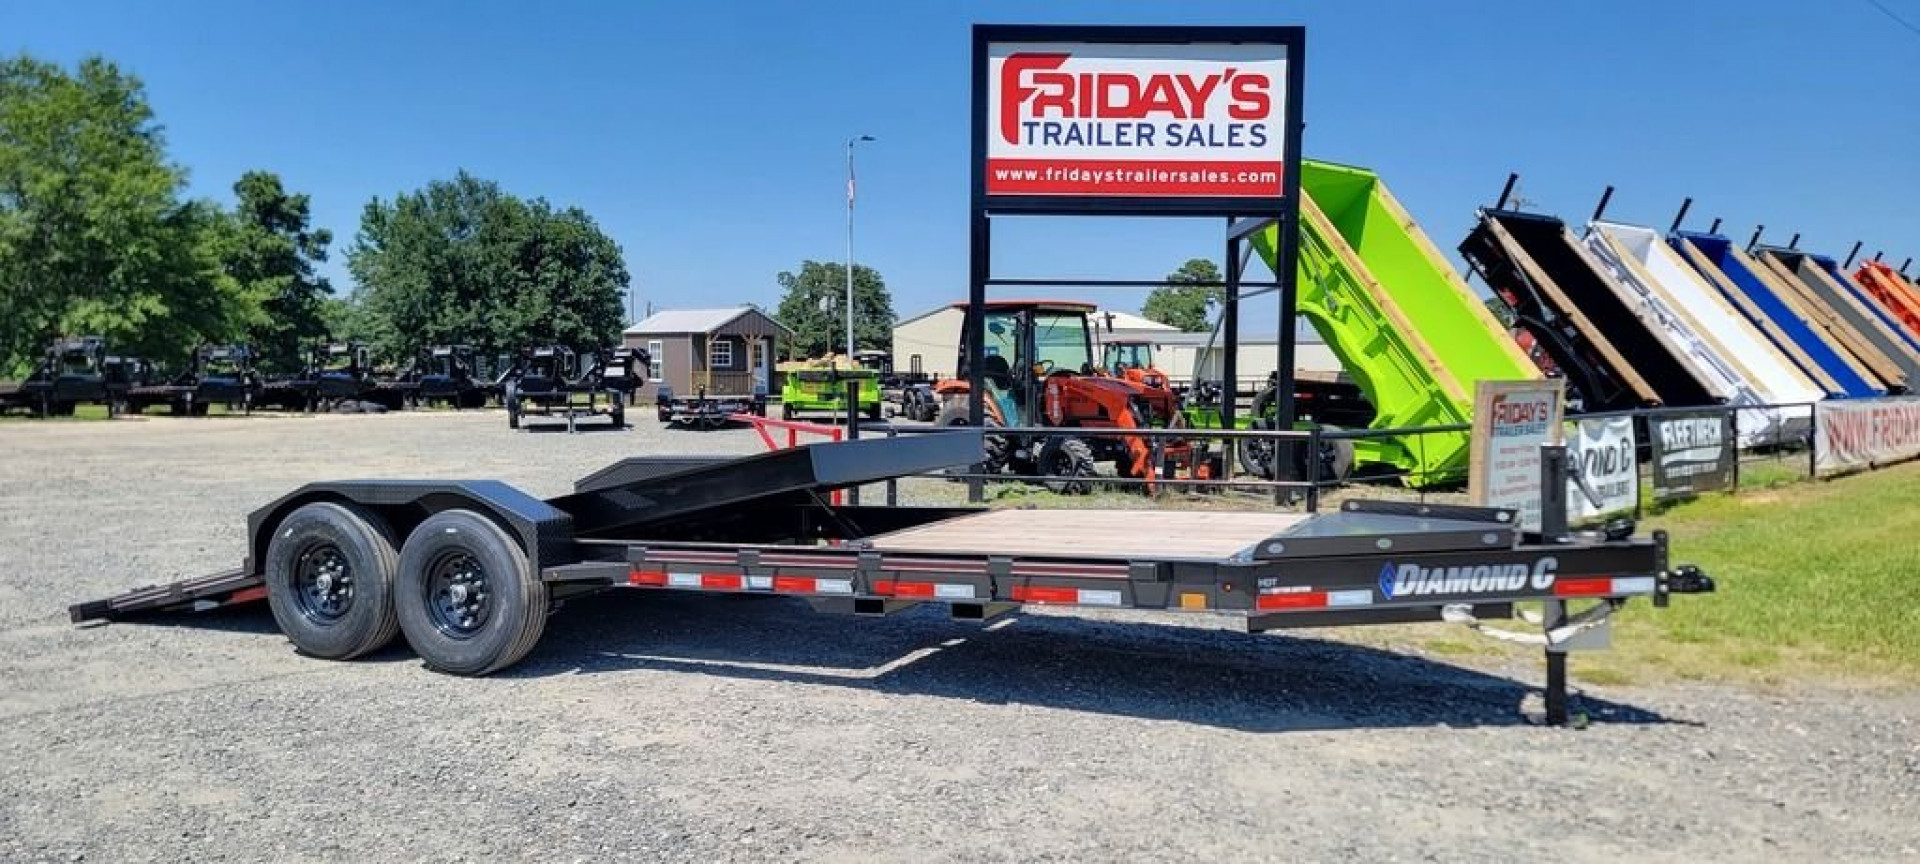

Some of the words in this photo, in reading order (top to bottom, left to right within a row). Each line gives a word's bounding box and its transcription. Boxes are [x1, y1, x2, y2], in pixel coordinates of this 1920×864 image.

[1001, 52, 1270, 145] FRIDAY'S
[1023, 121, 1156, 147] TRAILER
[1165, 122, 1267, 148] SALES
[995, 167, 1276, 184] www.fridaystrailersales.com
[1391, 563, 1528, 596] DIAMOND
[1531, 556, 1558, 590] C
